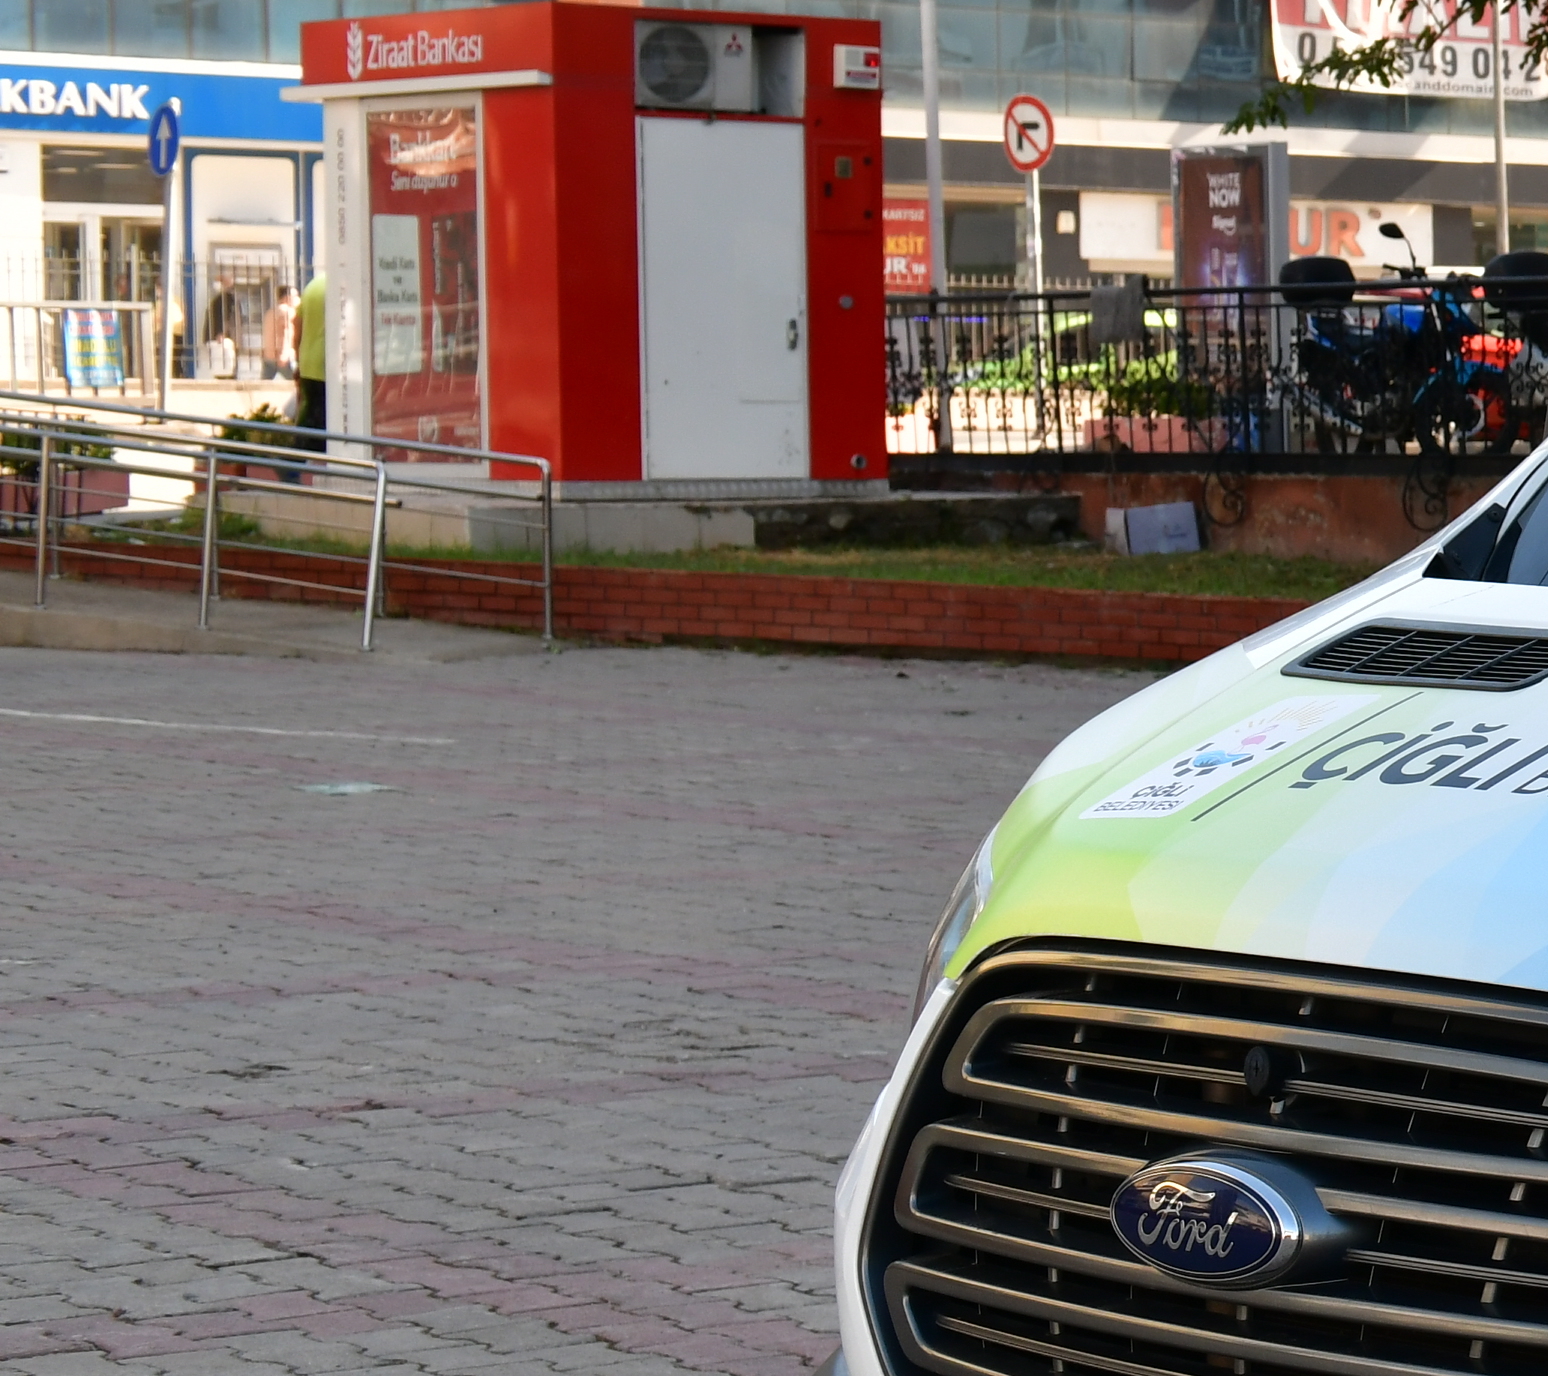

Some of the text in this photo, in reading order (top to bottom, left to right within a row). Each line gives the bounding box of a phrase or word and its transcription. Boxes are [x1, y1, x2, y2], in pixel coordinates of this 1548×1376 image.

[366, 29, 483, 70] Ziraat Bankası
[1209, 188, 1241, 209] NOW
[1138, 1181, 1239, 1258] Ford
